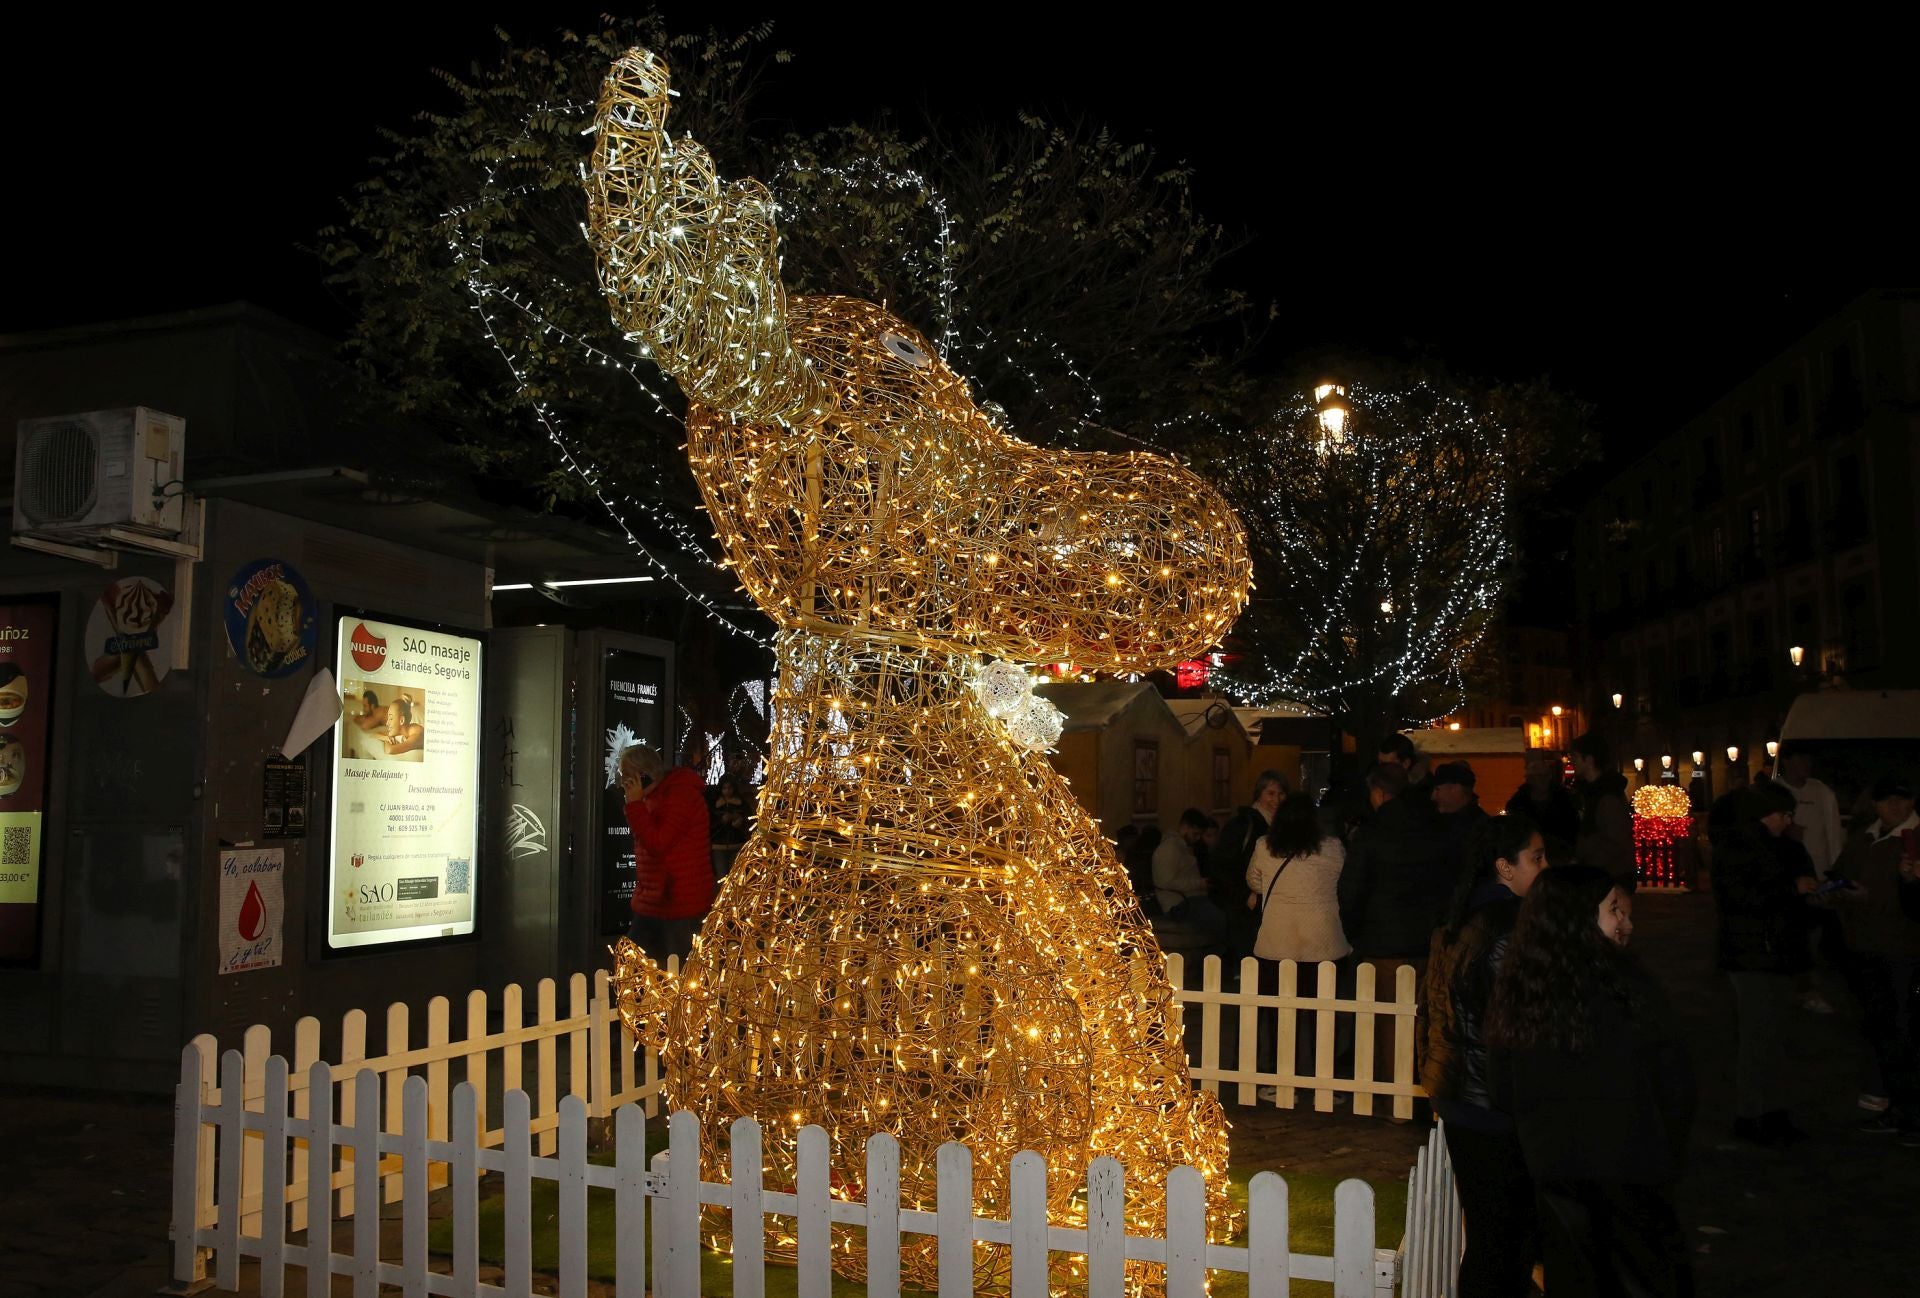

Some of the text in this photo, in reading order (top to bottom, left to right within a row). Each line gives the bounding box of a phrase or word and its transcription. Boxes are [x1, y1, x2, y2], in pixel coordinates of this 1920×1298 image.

[351, 642, 387, 656] NUEVO
[402, 636, 470, 664] SAO masaje
[391, 659, 469, 680] tailandés Segovia
[344, 768, 370, 780] Masaje
[371, 770, 403, 780] Relajante
[360, 883, 394, 904] SAO
